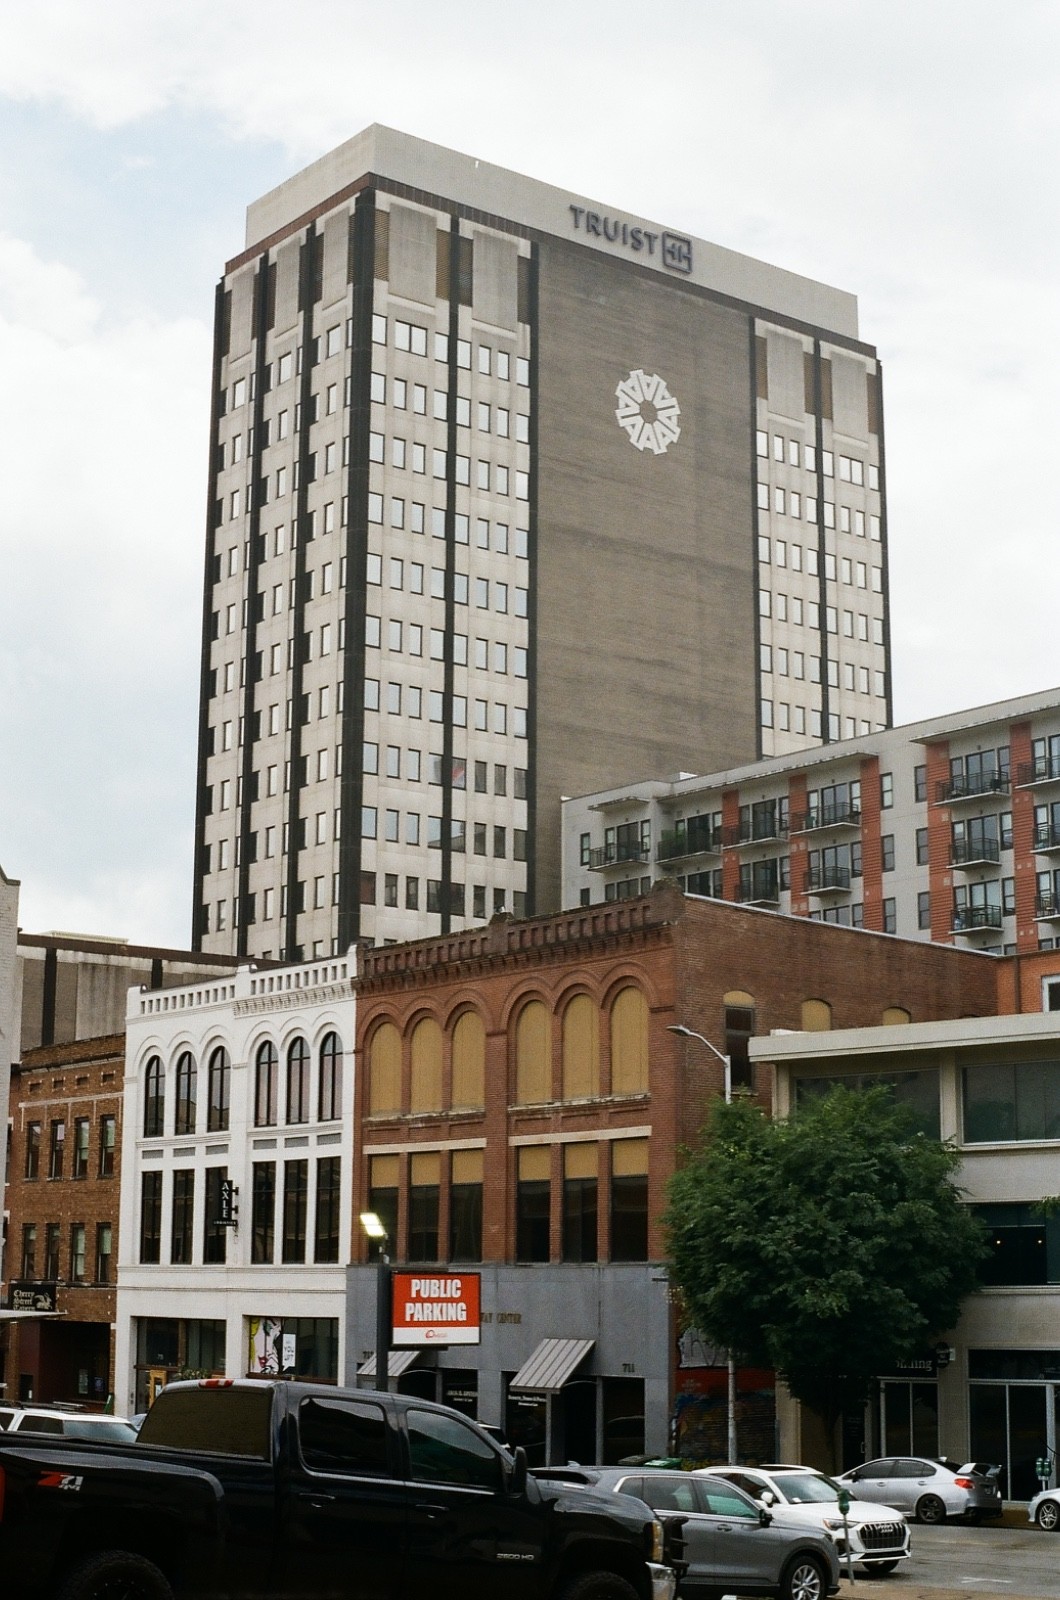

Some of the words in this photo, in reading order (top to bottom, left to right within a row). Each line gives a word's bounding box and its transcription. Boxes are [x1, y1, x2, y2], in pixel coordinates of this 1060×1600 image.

[569, 204, 658, 254] TRUIST
[221, 1182, 229, 1218] AXLE
[410, 1279, 461, 1298] PUBLIC
[405, 1302, 467, 1321] PARKING
